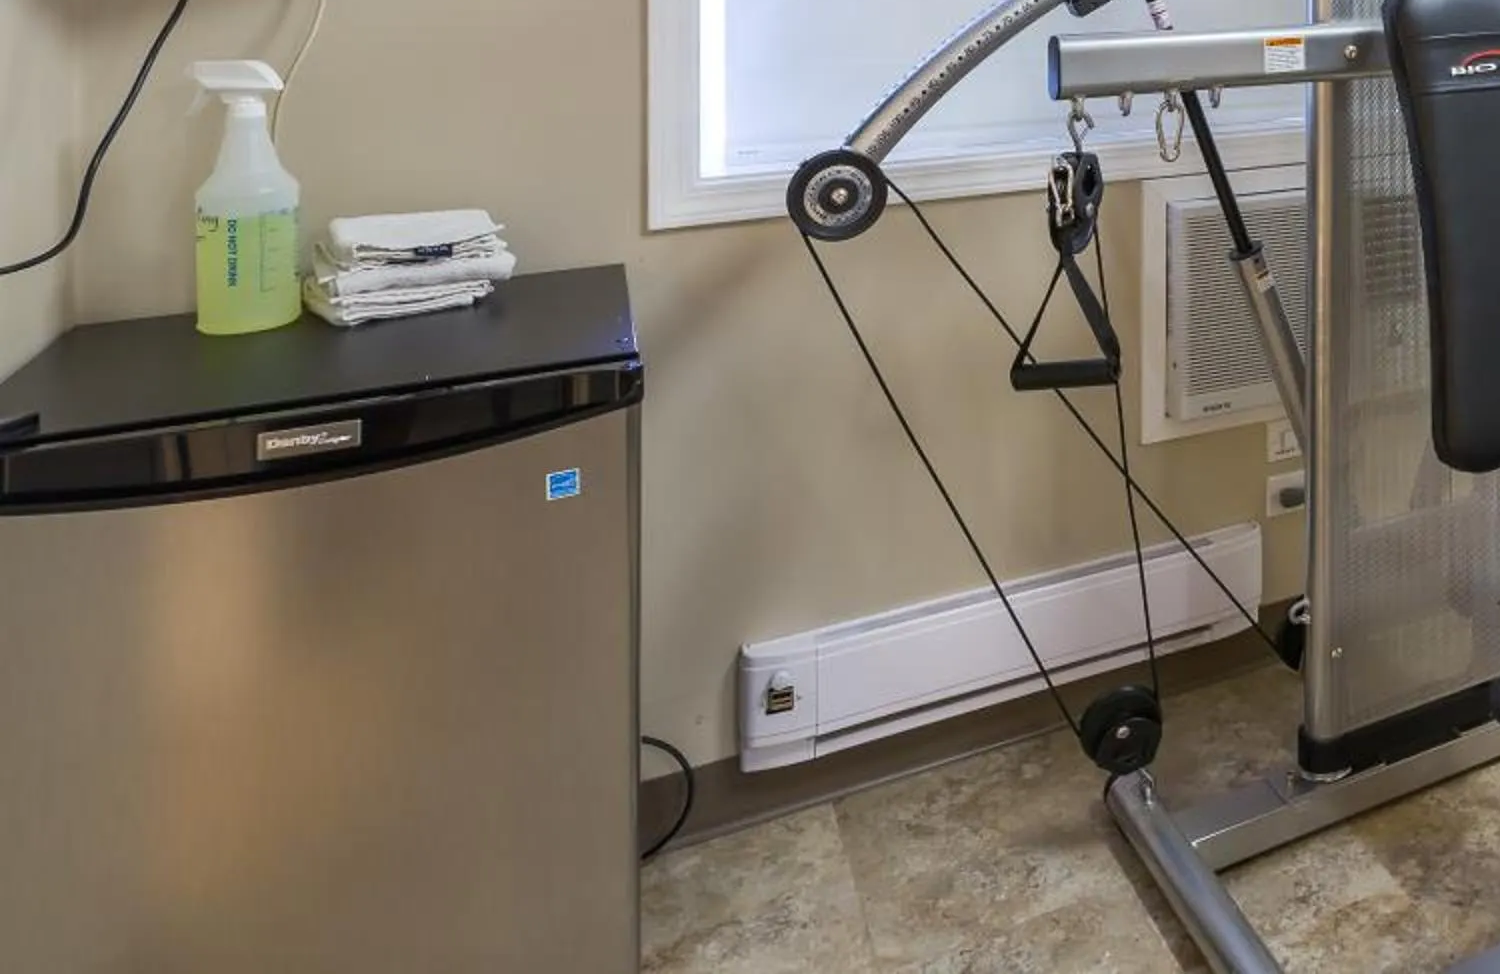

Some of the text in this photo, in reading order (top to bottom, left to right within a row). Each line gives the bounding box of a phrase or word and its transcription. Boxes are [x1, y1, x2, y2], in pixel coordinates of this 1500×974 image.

[1450, 62, 1498, 77] BIO
[227, 219, 237, 234] DO
[227, 235, 237, 255] NOT
